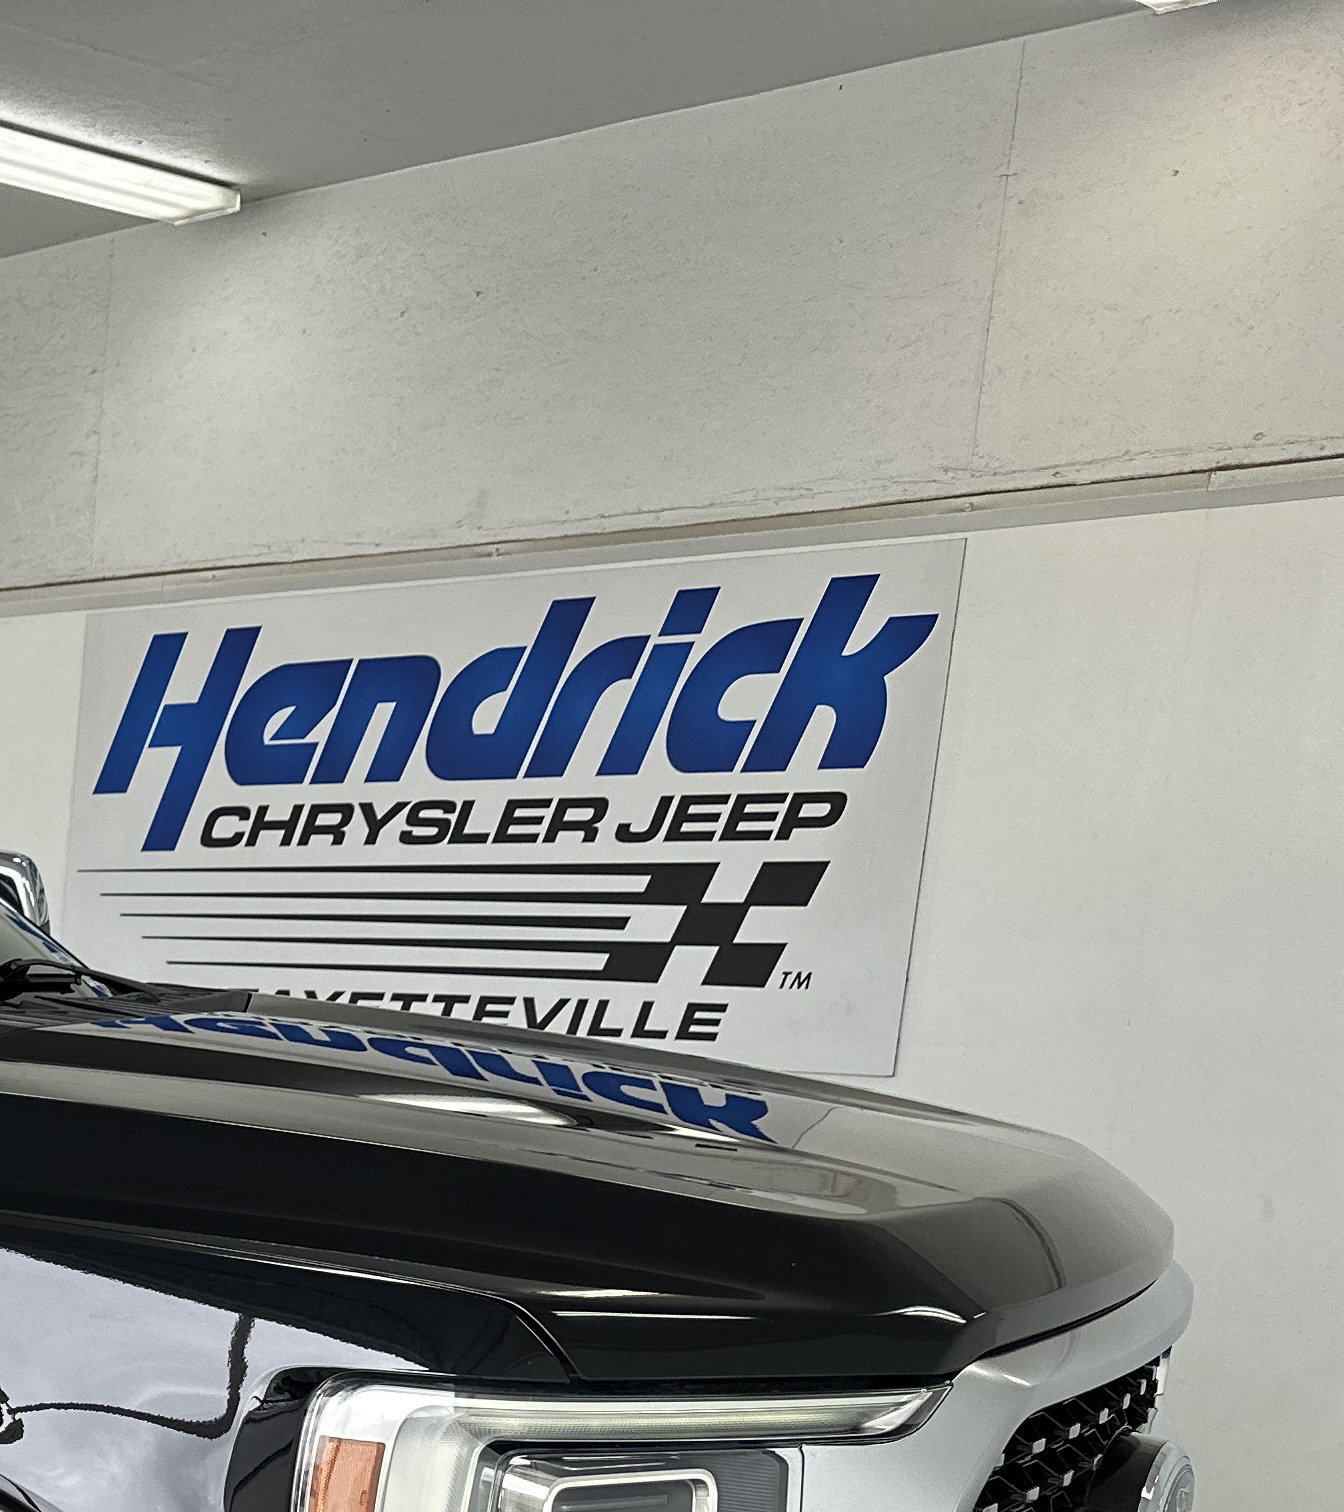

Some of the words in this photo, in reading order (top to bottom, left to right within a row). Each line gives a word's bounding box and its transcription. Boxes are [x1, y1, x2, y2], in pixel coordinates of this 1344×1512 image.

[93, 574, 939, 852] Hendrick
[199, 796, 610, 849] CHRYSLER
[615, 791, 848, 844] JEEP
[779, 970, 813, 991] TM
[247, 988, 729, 1041] TTEVILLE
